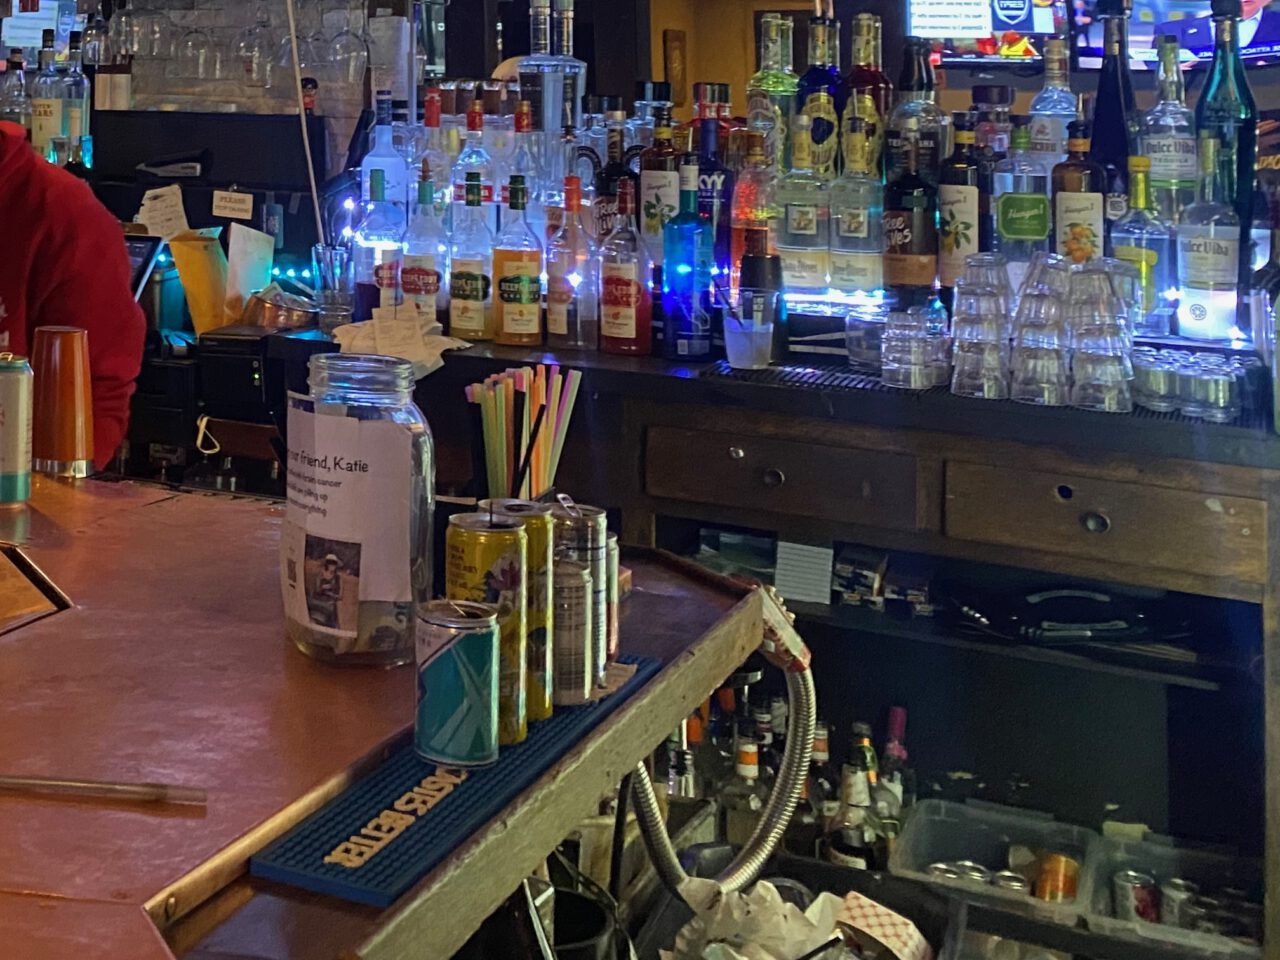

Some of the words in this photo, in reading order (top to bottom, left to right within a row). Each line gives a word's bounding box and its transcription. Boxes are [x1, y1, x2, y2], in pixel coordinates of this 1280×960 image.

[698, 175, 726, 190] KYY
[301, 450, 331, 473] friend,
[333, 456, 369, 473] Katie
